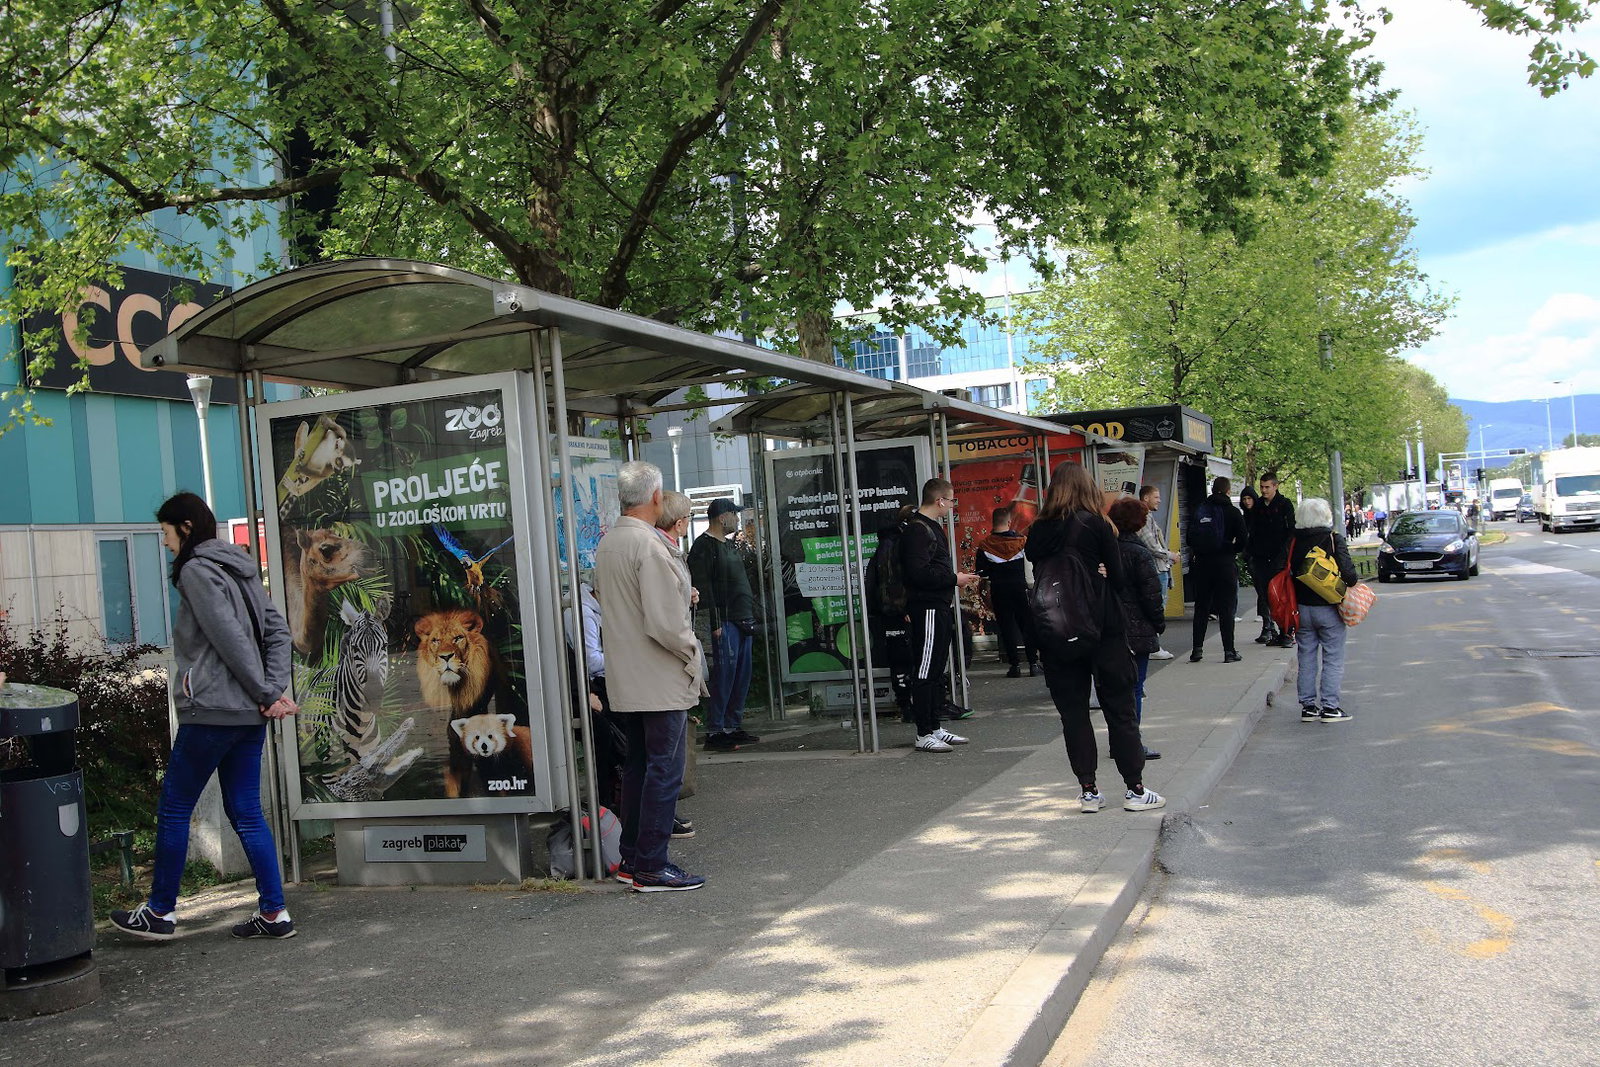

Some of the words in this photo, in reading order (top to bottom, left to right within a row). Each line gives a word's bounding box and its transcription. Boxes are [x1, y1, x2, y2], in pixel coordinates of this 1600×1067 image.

[445, 403, 501, 431] ZOO
[469, 426, 502, 441] Zagreb
[957, 436, 1029, 452] TOBACCO
[373, 457, 501, 508] PROLJEĆE
[788, 492, 822, 505] Prebaci
[876, 485, 908, 497] banku,
[376, 512, 386, 528] U
[388, 503, 467, 527] ZOOLOŠKOM
[470, 502, 507, 520] VRTU
[789, 506, 823, 519] ugovori
[873, 499, 900, 512] paket
[795, 519, 815, 531] čeka
[816, 518, 829, 529] te:
[488, 776, 527, 791] zoo.hr
[382, 836, 422, 851] zagreb
[427, 836, 461, 851] plakat
